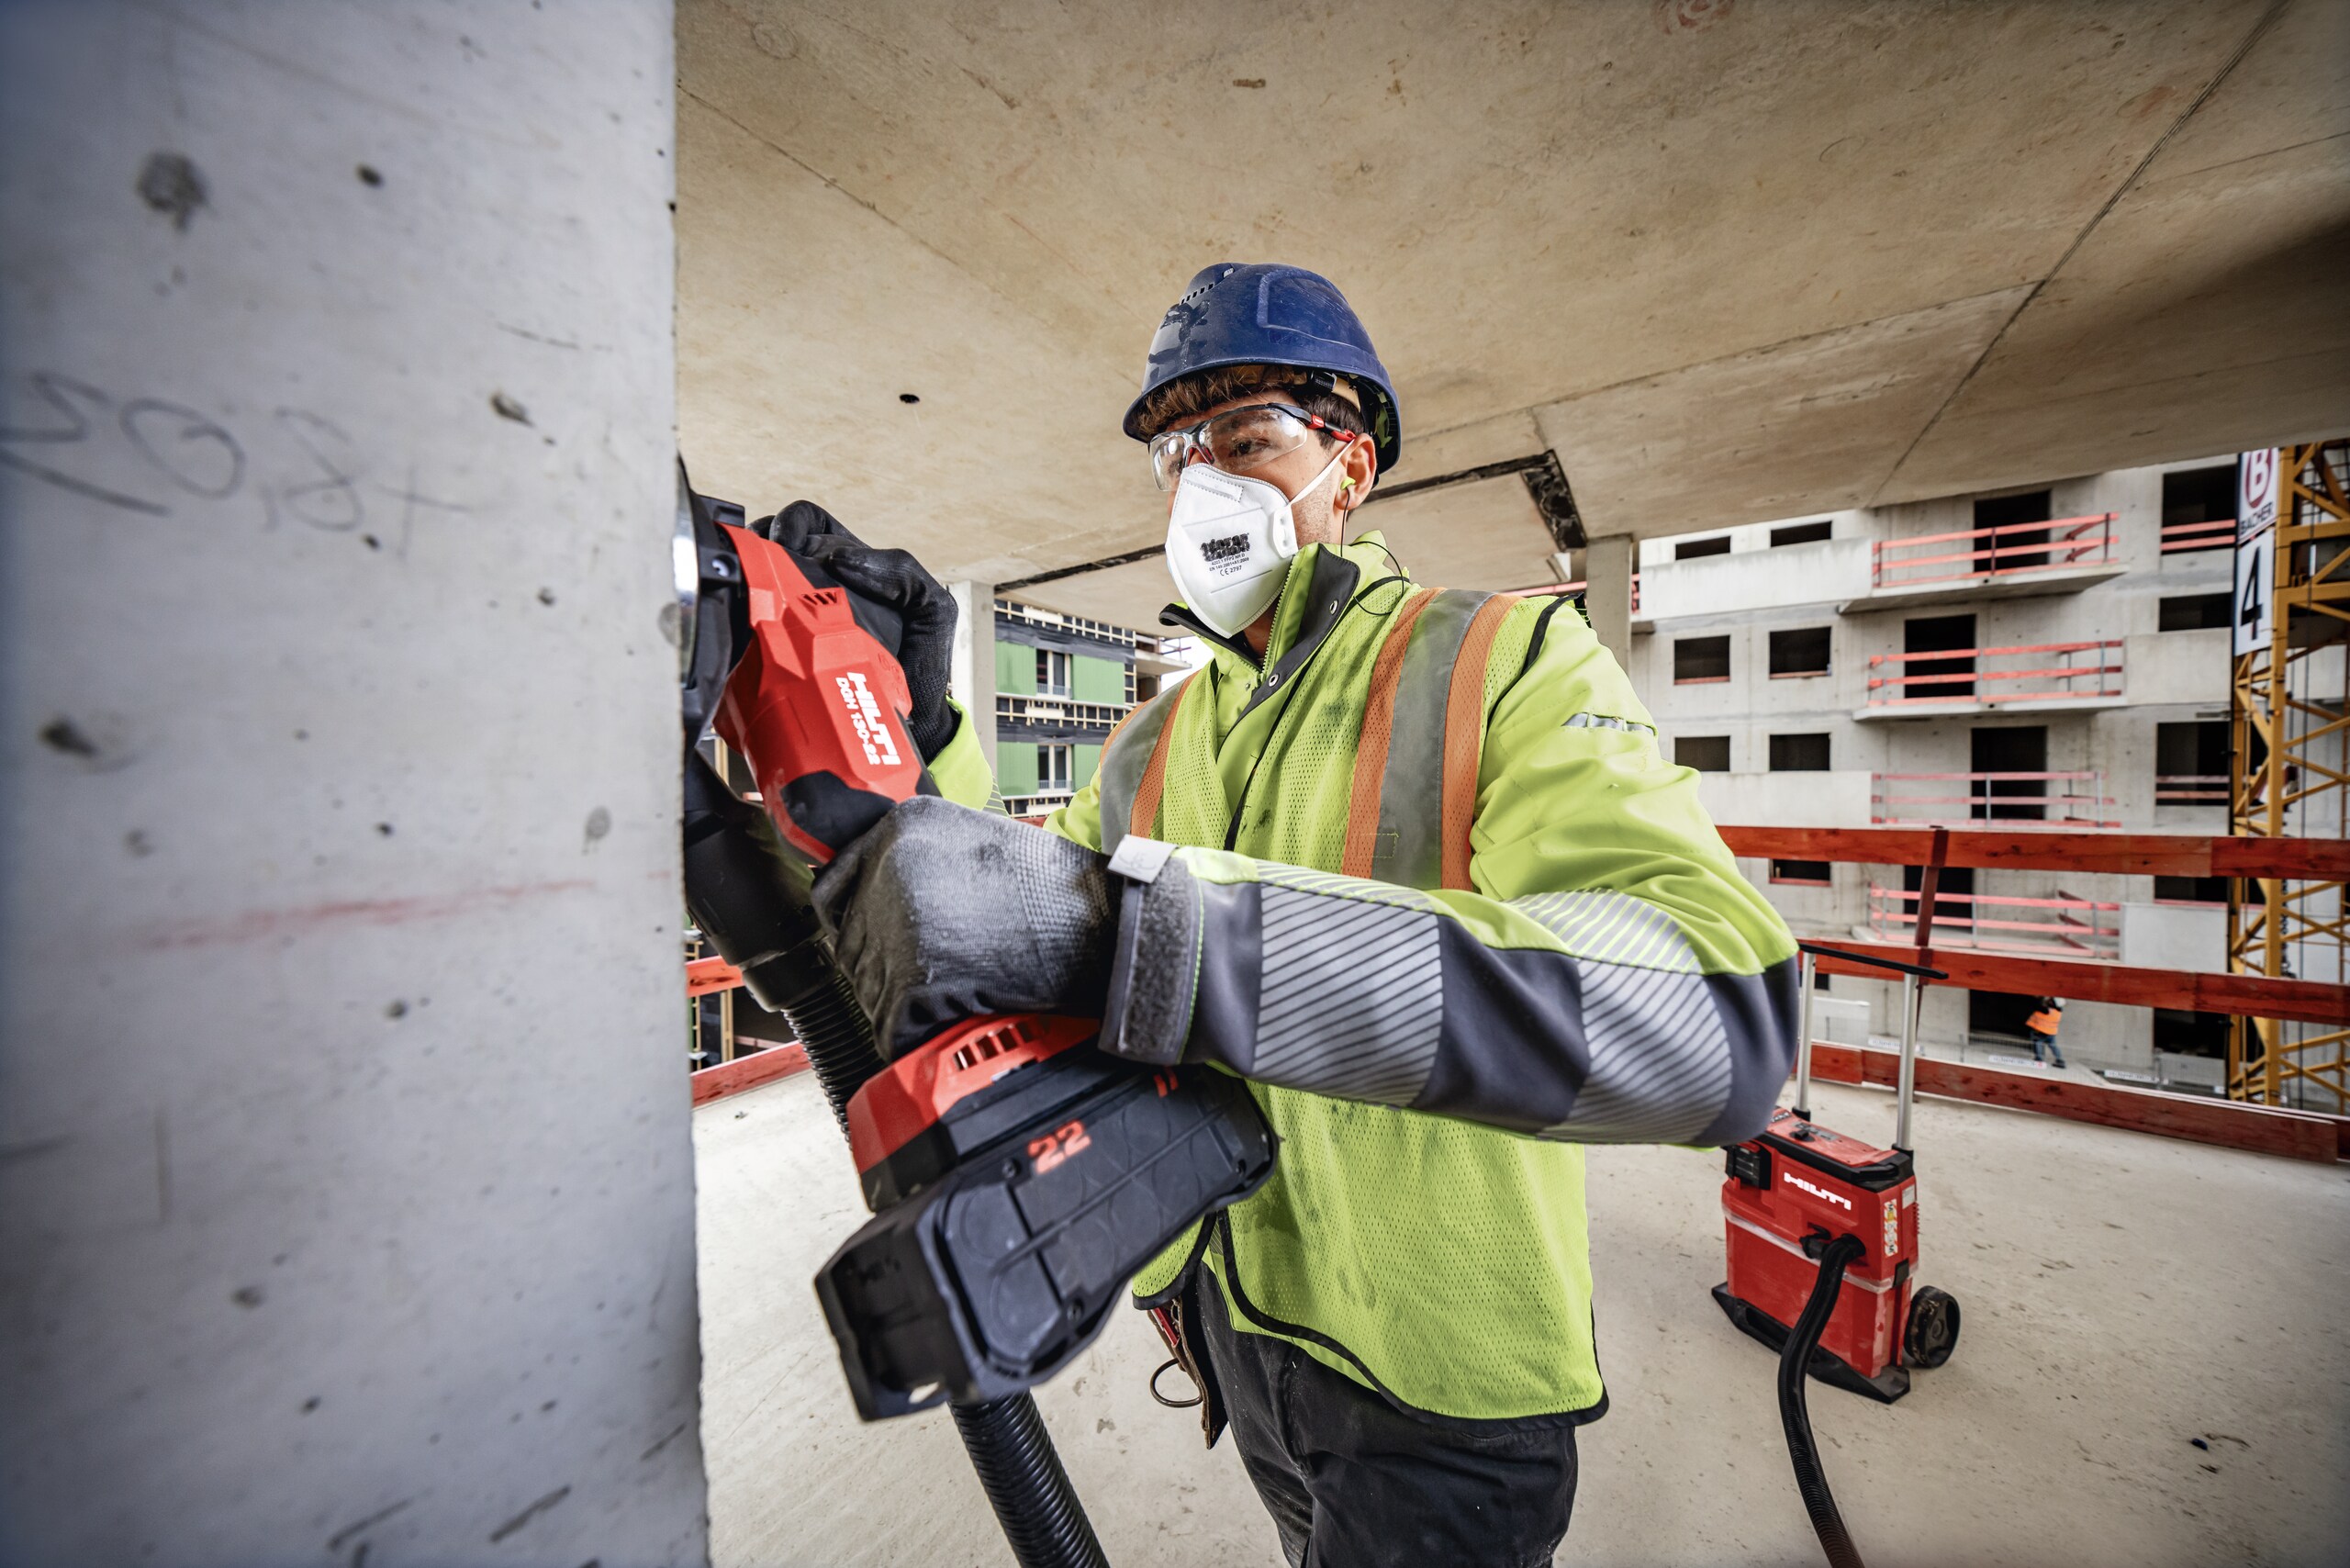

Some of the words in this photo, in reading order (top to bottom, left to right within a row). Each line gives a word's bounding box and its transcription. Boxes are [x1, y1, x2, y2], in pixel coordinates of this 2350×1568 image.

[2241, 545, 2263, 641] 4
[846, 672, 901, 766] HILTI
[1027, 1119, 1092, 1175] 22
[1784, 1171, 1852, 1211] HILTI
